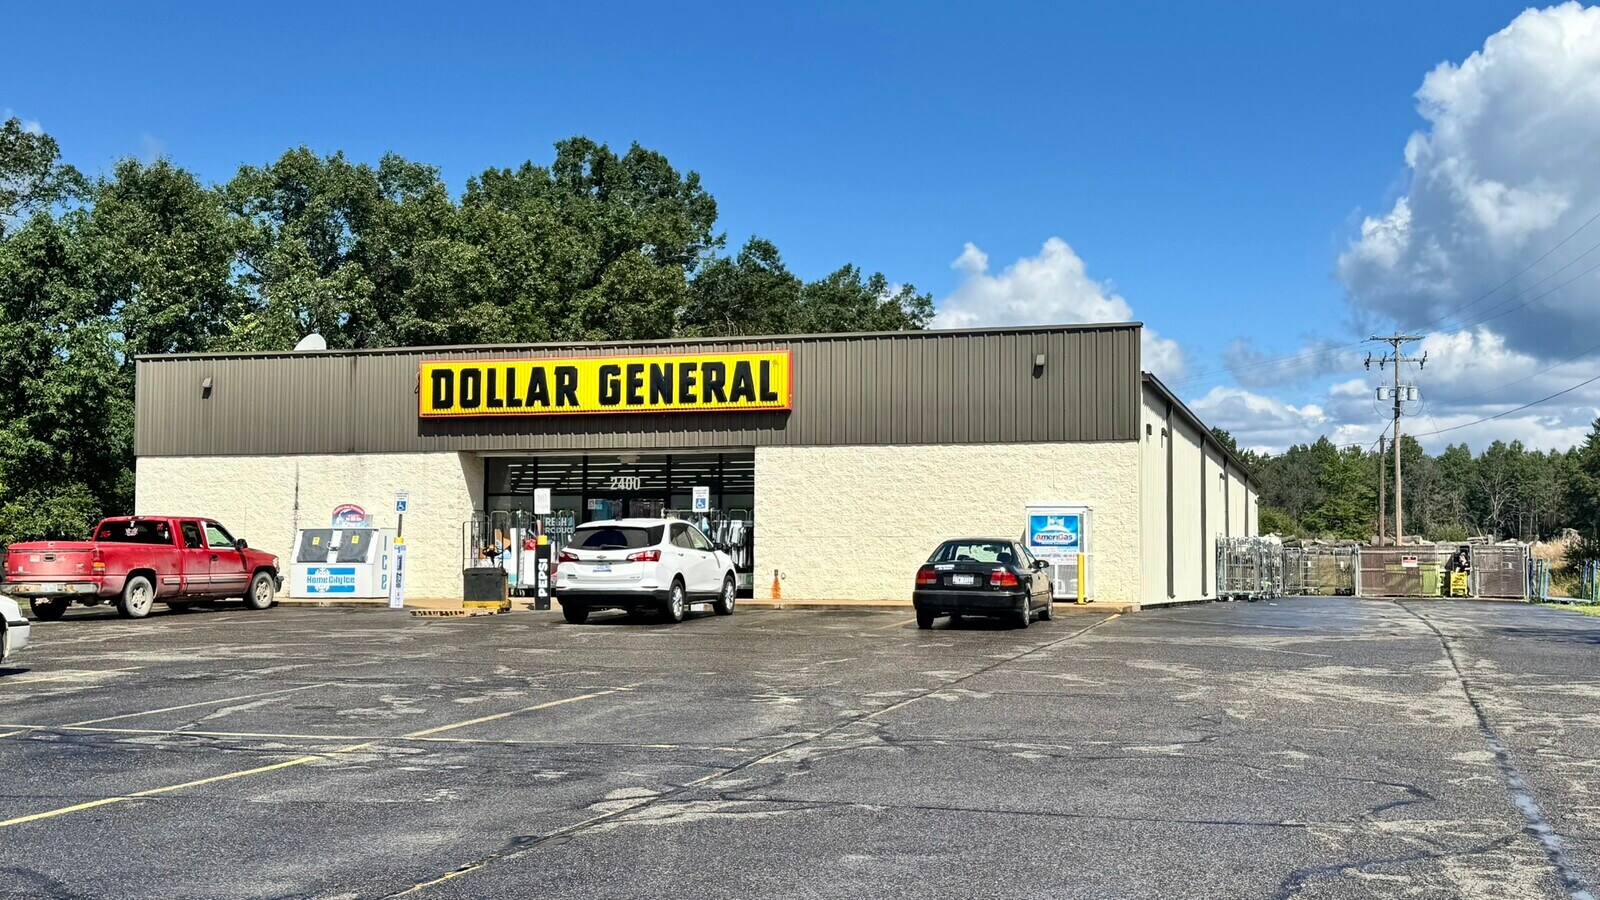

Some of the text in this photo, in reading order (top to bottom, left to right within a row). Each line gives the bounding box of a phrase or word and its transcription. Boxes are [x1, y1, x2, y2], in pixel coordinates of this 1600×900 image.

[431, 360, 778, 410] DOLLAR GENERAL
[610, 477, 641, 490] 2400
[545, 517, 567, 526] RESH
[1035, 533, 1074, 541] AmeriGas
[306, 576, 355, 585] Home City Ice
[538, 558, 548, 597] PEPSI
